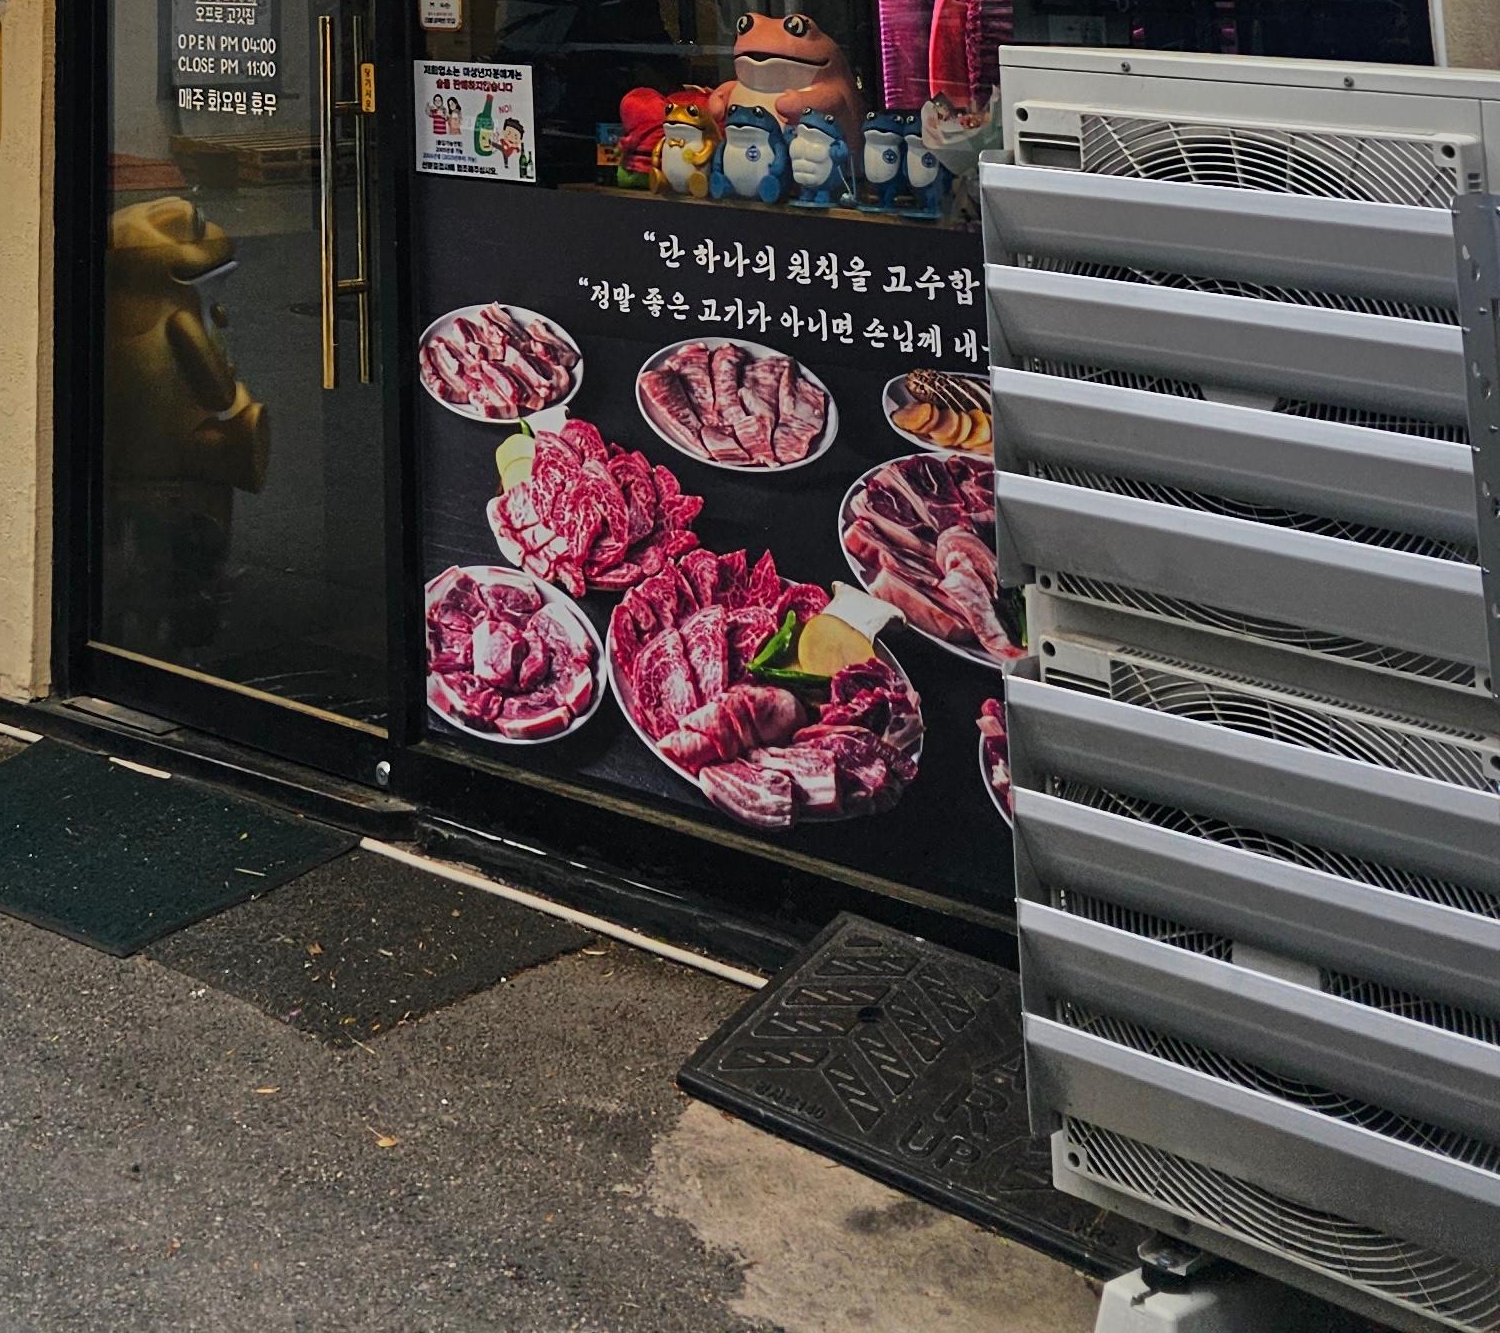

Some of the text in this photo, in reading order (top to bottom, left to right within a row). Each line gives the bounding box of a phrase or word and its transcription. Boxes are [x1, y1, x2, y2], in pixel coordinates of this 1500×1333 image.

[196, 6, 255, 25] 오프로 고깃집
[178, 34, 277, 55] OPEN PM 04:00
[178, 56, 277, 78] CLOSE PM 11:00
[178, 87, 277, 117] 매주 화요일 휴무
[693, 238, 777, 282] 하나의
[786, 250, 873, 294] 원칙을
[642, 286, 691, 320] 좋은
[697, 296, 772, 334] 고기가
[780, 306, 854, 344] 아니면
[862, 317, 942, 358] 손님께
[954, 328, 990, 363] 내
